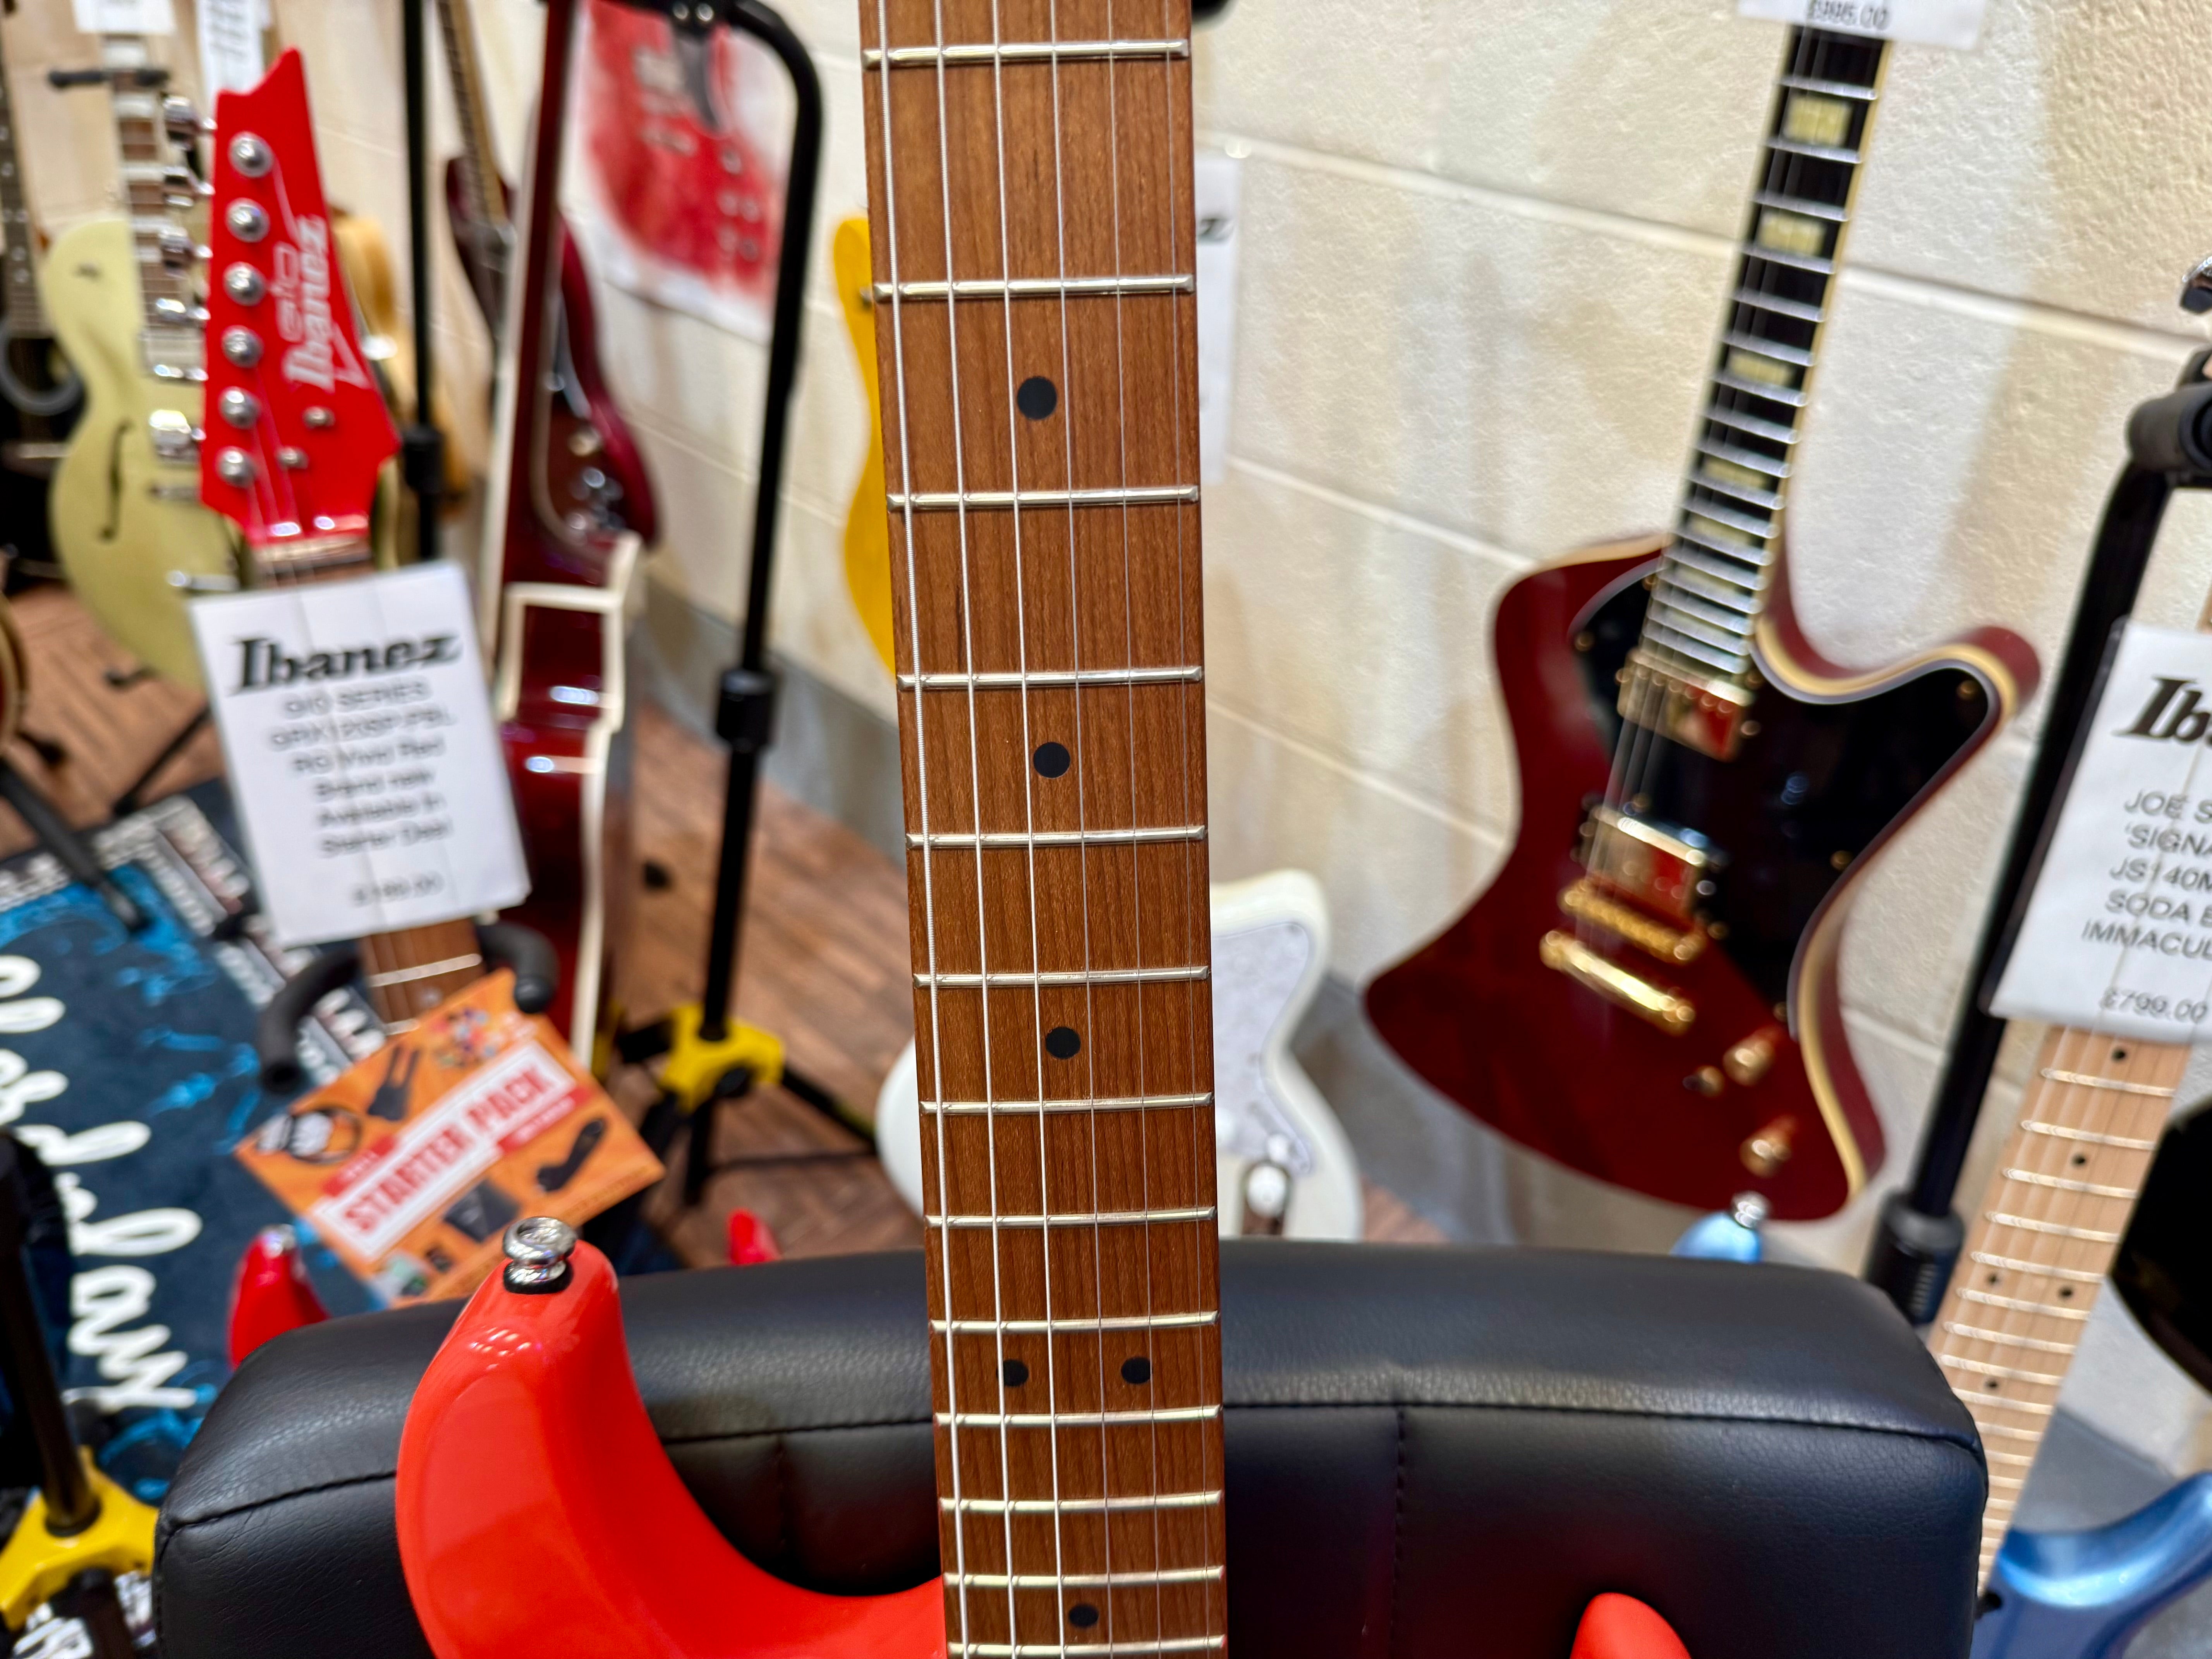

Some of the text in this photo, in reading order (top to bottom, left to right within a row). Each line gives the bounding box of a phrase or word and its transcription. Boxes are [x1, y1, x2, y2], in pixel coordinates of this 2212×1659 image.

[283, 214, 335, 393] Ibanez
[228, 630, 460, 696] Ibanez
[2111, 675, 2212, 749] Ib
[2123, 789, 2188, 819] JOE
[2105, 890, 2189, 924] SODA
[2099, 986, 2207, 1024] £799.00
[342, 1123, 473, 1233] STARTER
[464, 1064, 553, 1135] PACK
